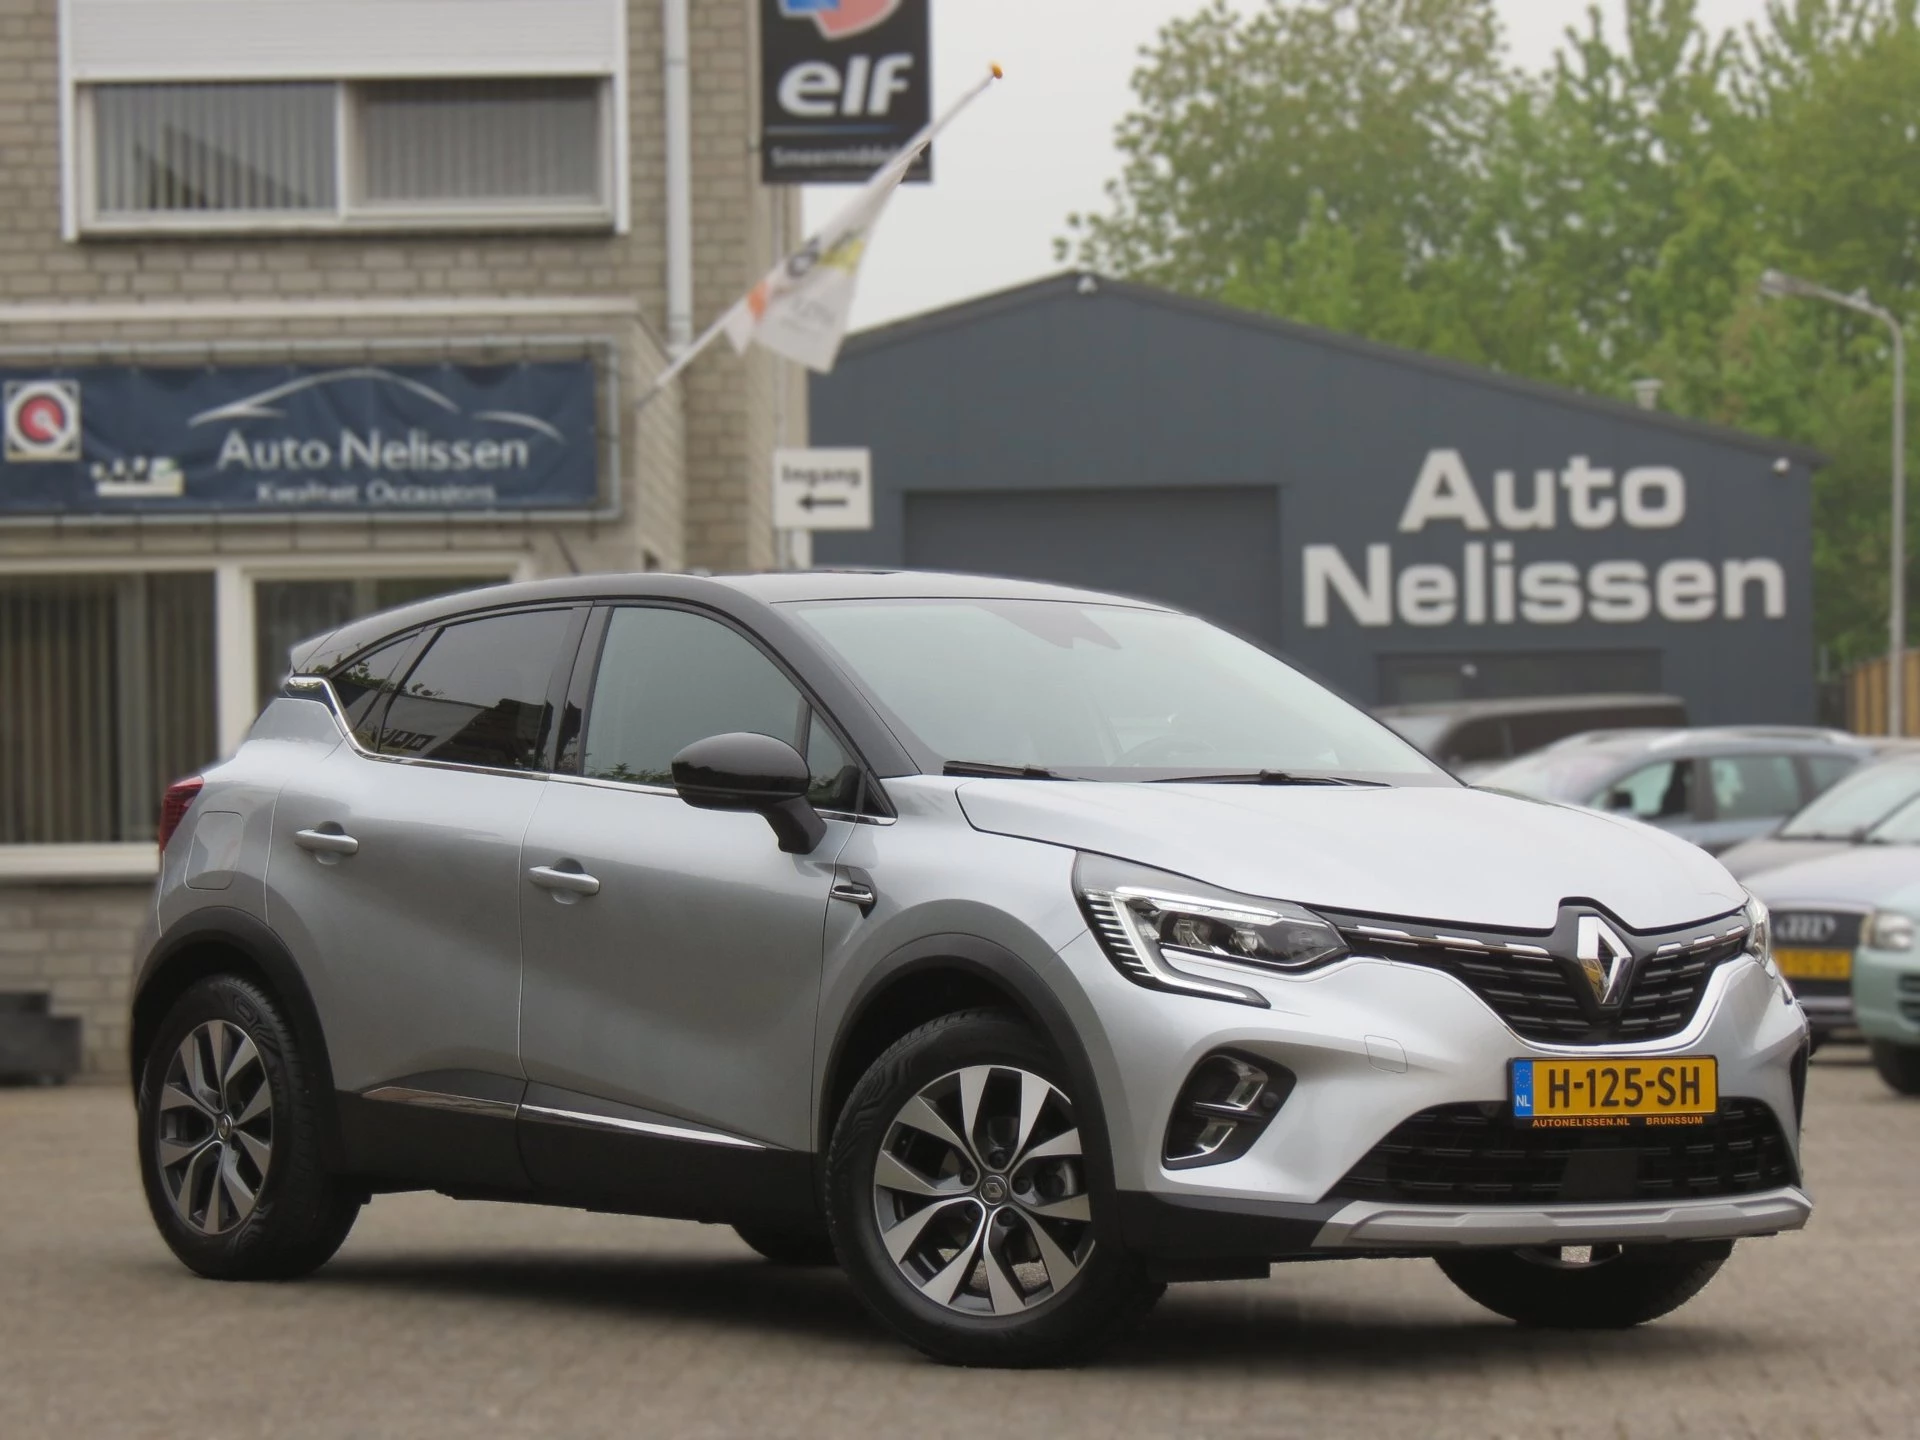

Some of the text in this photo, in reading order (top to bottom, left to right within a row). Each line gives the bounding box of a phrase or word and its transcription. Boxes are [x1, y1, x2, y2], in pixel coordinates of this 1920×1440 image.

[777, 53, 914, 117] elf
[217, 428, 529, 471] Auto Nelissen
[1398, 448, 1687, 533] Auto
[1302, 540, 1787, 628] Nelissen
[1516, 1066, 1700, 1109] NL H-125-SH
[1532, 1116, 1703, 1127] AUTONELISSEN.NL BRUNSSUM
